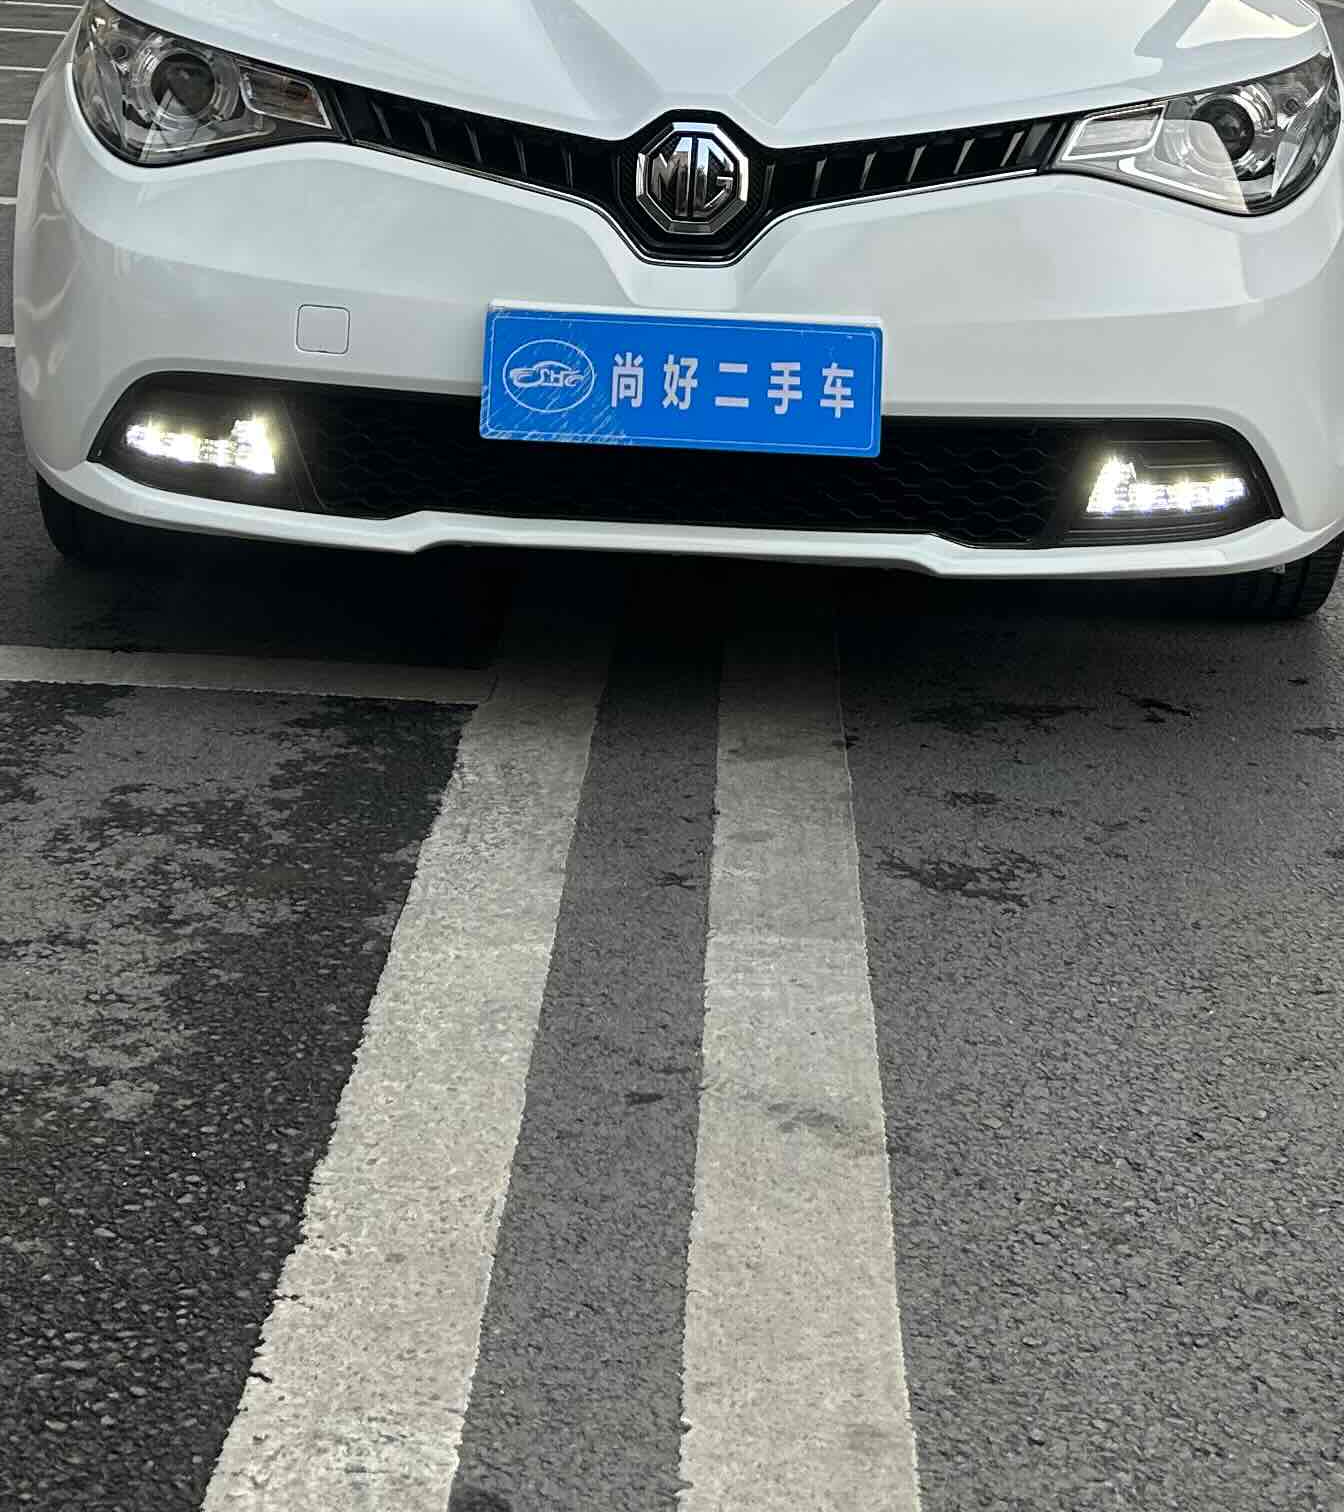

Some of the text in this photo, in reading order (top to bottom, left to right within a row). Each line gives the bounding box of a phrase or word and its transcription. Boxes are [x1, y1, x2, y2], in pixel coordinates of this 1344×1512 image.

[650, 136, 735, 218] MG
[610, 350, 856, 419] 尚好二手车
